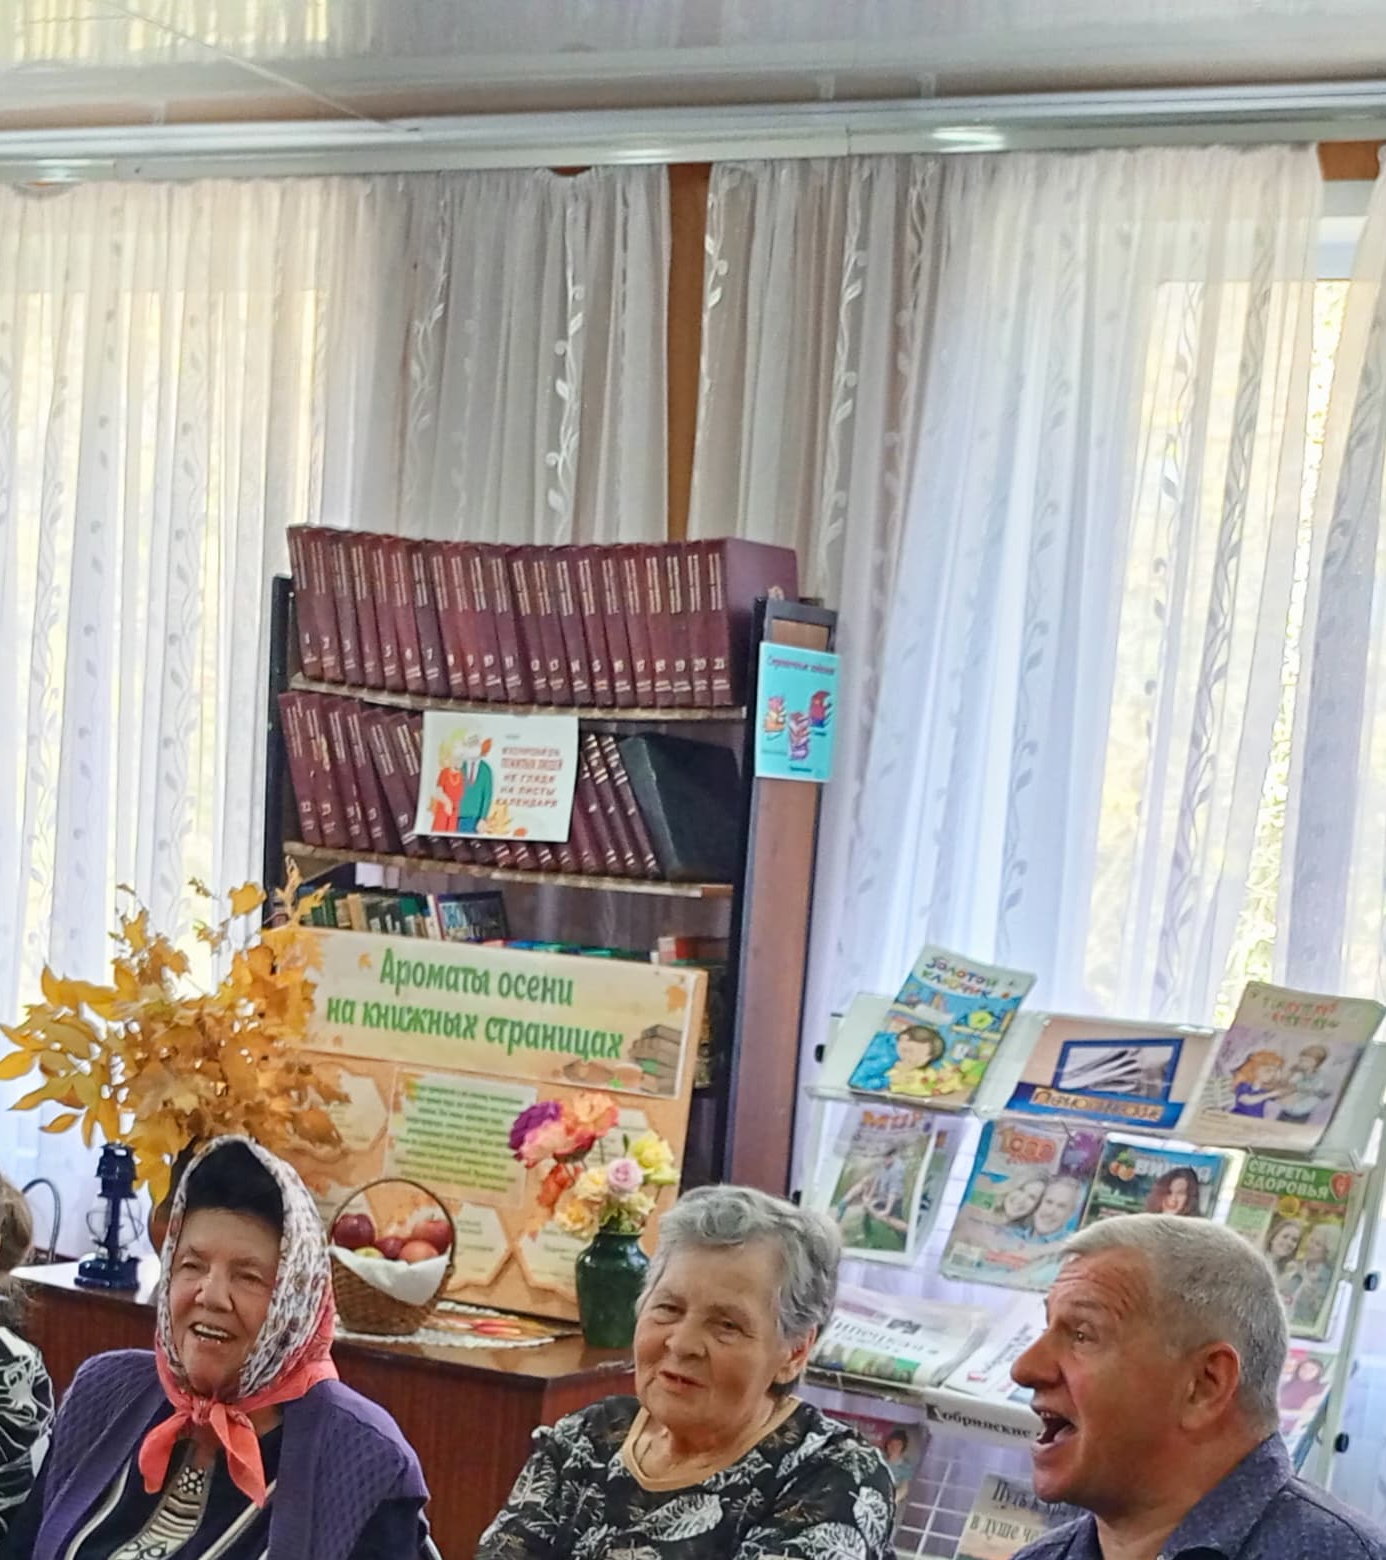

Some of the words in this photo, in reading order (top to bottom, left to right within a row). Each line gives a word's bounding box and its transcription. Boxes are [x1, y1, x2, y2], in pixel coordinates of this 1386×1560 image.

[379, 947, 491, 997] Ароматы
[498, 970, 574, 1007] осени
[326, 996, 356, 1025] на
[363, 999, 479, 1041] книжных
[485, 1015, 624, 1060] страницах
[1248, 1158, 1318, 1182] СЕКРЕТЫ
[1243, 1172, 1330, 1200] ЗДОРОВЬЯ
[984, 1519, 1019, 1541] душе
